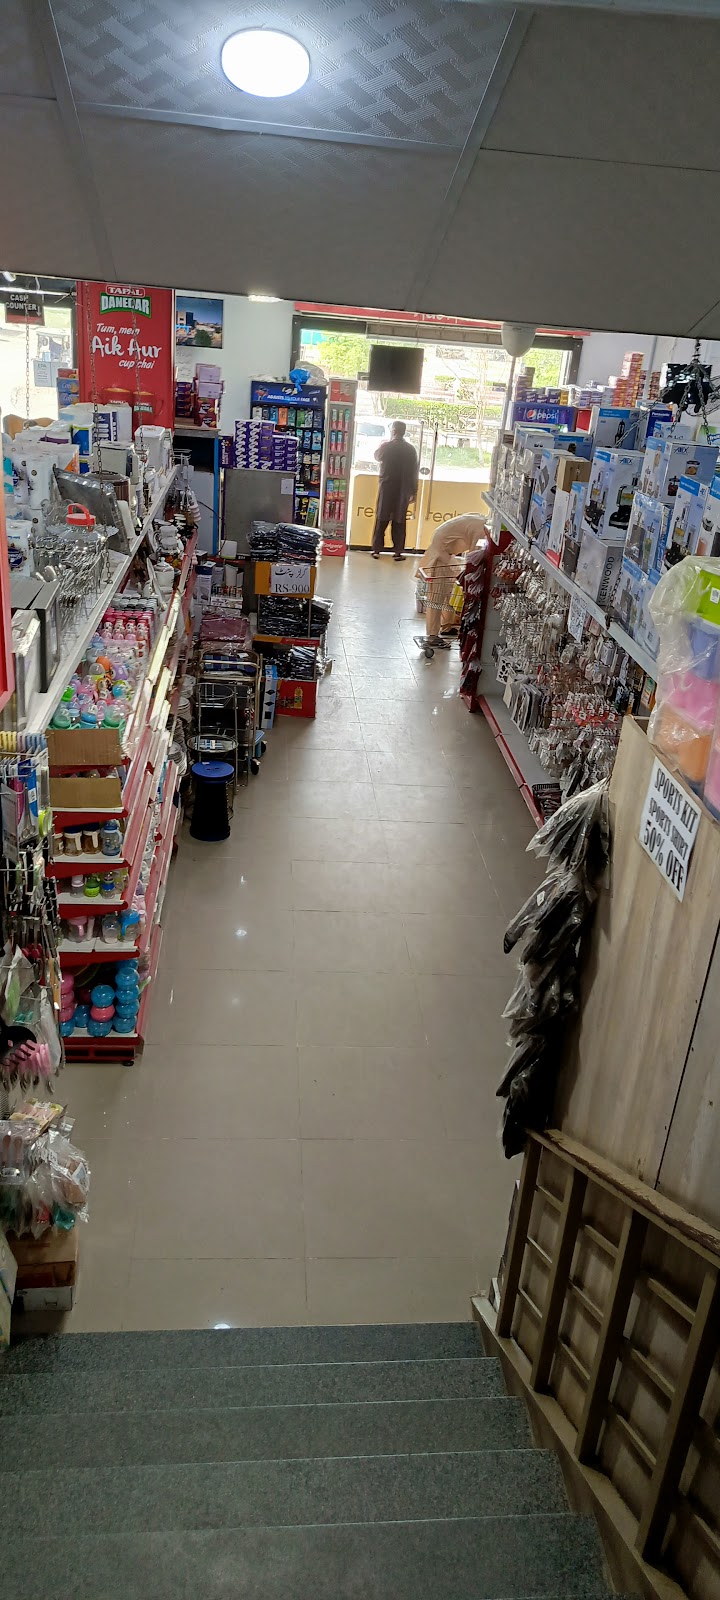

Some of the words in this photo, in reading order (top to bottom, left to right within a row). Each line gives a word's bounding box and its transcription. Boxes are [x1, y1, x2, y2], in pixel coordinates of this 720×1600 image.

[108, 287, 142, 296] TAPAL
[10, 294, 29, 302] CASH
[5, 302, 37, 311] COUNTER
[96, 323, 117, 335] Tum,
[119, 327, 140, 335] mein
[92, 335, 125, 358] Aik
[127, 339, 162, 359] Aur
[118, 359, 135, 369] cup
[136, 358, 155, 369] chai
[537, 409, 558, 420] pepsi
[598, 556, 615, 603] KENWOOD
[275, 583, 310, 593] RS-900
[654, 767, 683, 816] SPORTS
[680, 800, 698, 834] KIT
[648, 797, 672, 837] SPORTS
[670, 825, 689, 861] SHIRT
[643, 819, 665, 867] 50%
[665, 849, 684, 892] OFF
